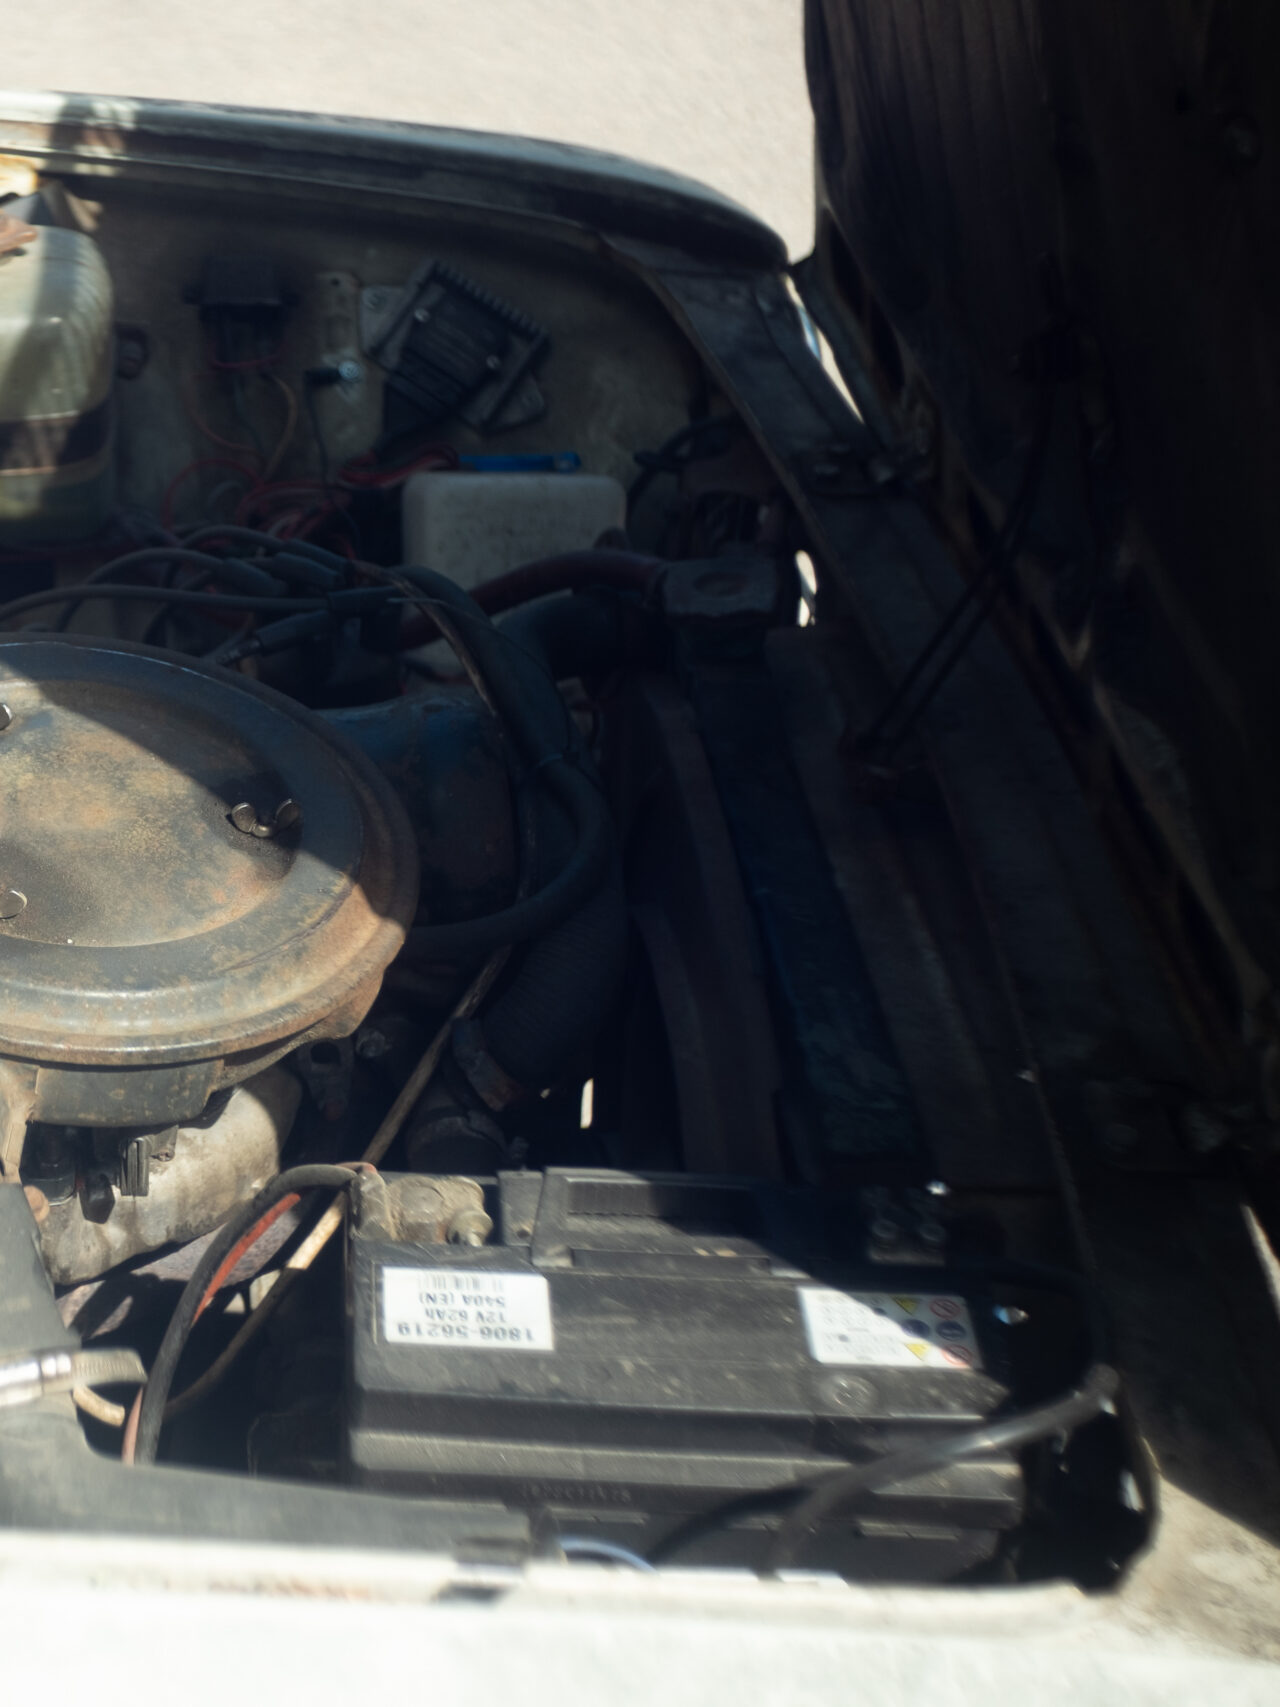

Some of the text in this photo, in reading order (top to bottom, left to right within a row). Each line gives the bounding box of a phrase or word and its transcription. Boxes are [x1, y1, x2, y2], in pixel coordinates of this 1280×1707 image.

[425, 1308, 505, 1322] 12V 62Ah
[397, 1322, 534, 1341] 1806-56219
